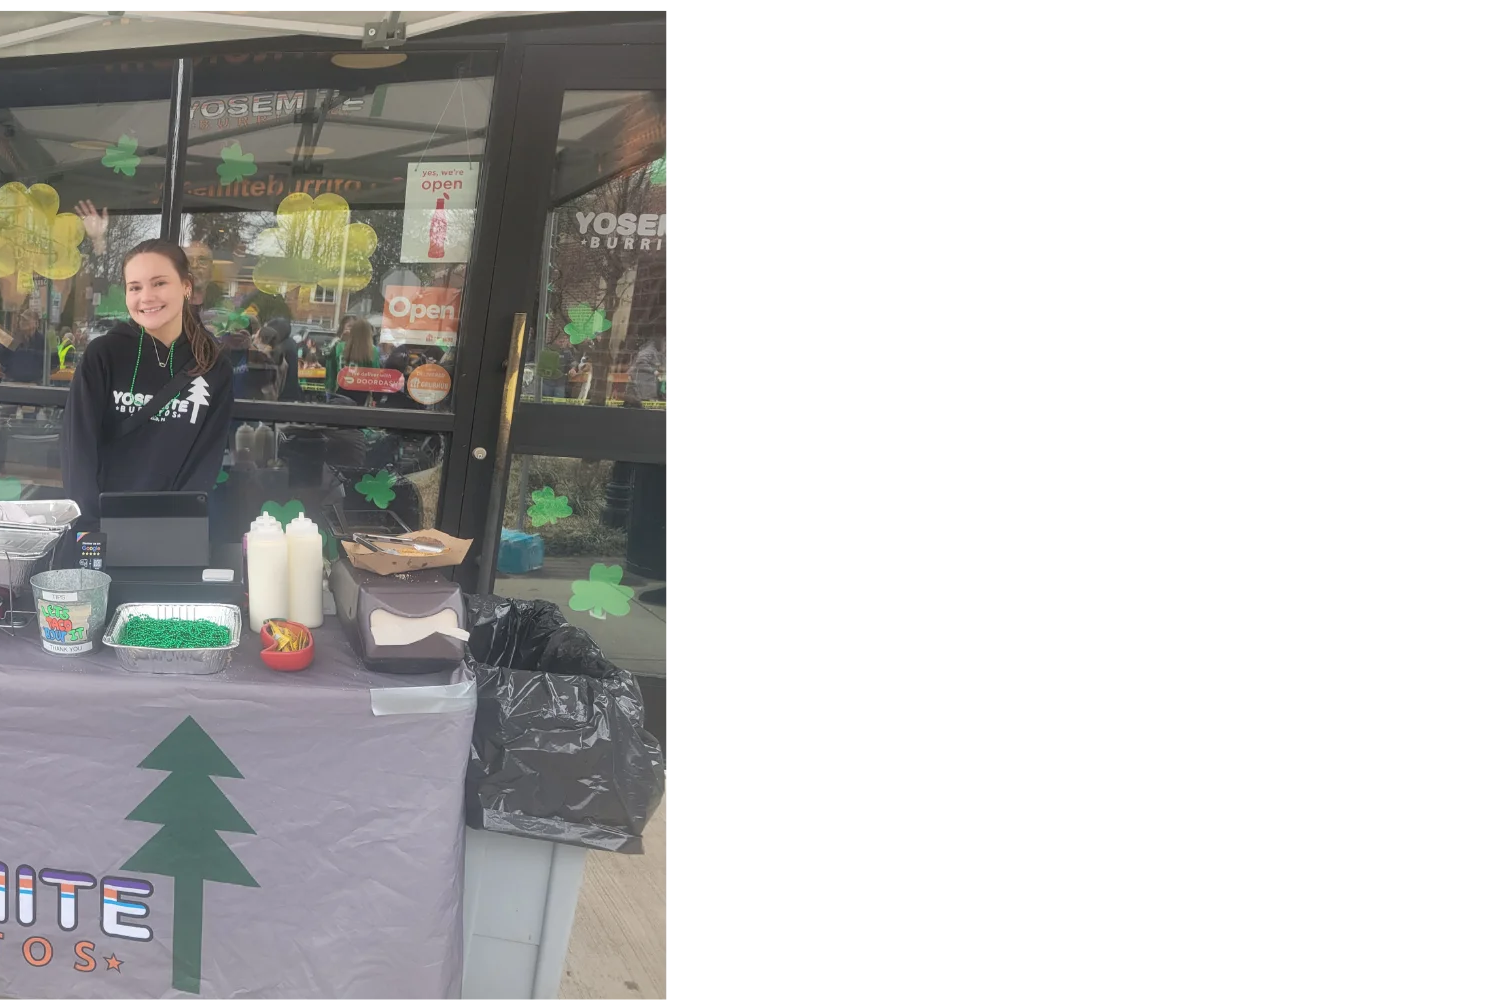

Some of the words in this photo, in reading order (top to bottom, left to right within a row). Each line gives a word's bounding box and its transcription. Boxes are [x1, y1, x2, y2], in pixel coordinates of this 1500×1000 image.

[422, 170, 439, 178] yes,
[441, 168, 465, 176] we're
[421, 179, 463, 193] open
[589, 236, 663, 250] BURRI
[388, 296, 455, 324] Open
[45, 616, 73, 632] TACO
[68, 626, 85, 642] IT
[50, 644, 68, 652] THANK
